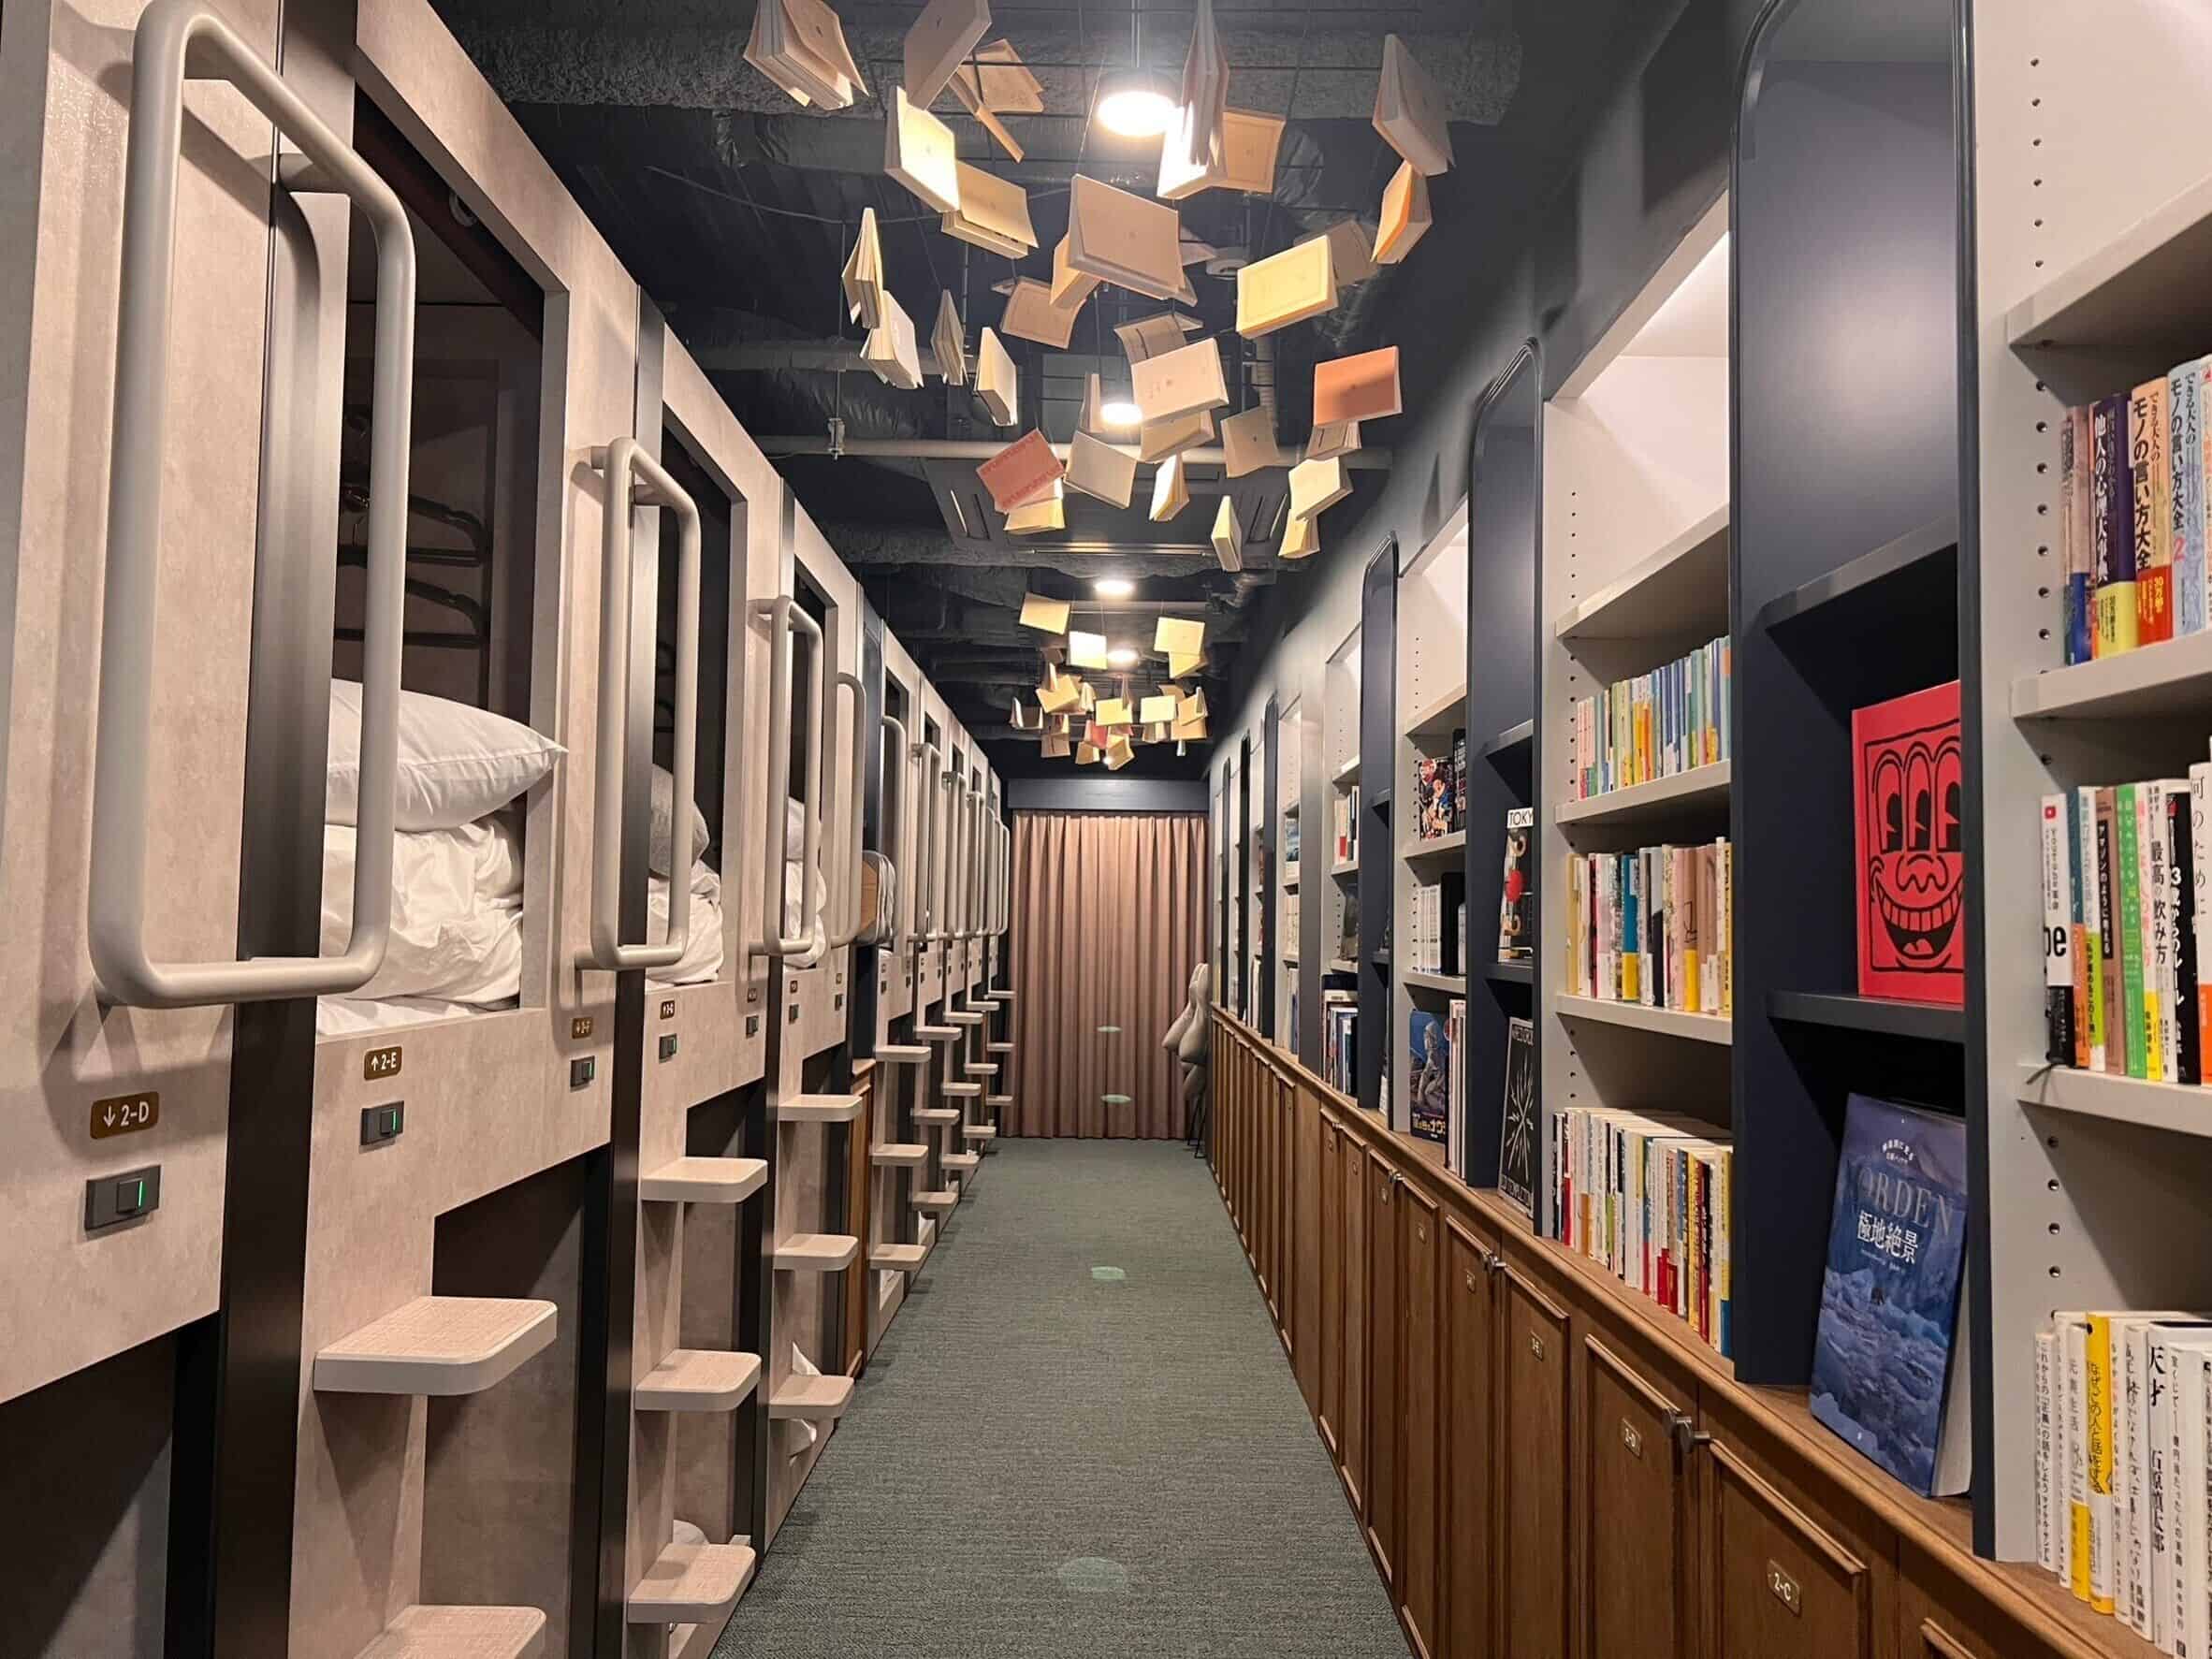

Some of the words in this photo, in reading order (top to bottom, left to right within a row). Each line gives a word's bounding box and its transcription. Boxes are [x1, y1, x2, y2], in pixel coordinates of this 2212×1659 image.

[2170, 377, 2185, 531] モノの言い方大全
[2133, 397, 2151, 570] モノの言い方大全
[2174, 537, 2186, 561] 2
[381, 1052, 397, 1070] 2-E
[120, 1101, 150, 1127] 2-D
[1857, 1210, 1918, 1264] 極地絶景
[1774, 1572, 1791, 1601] 2-C
